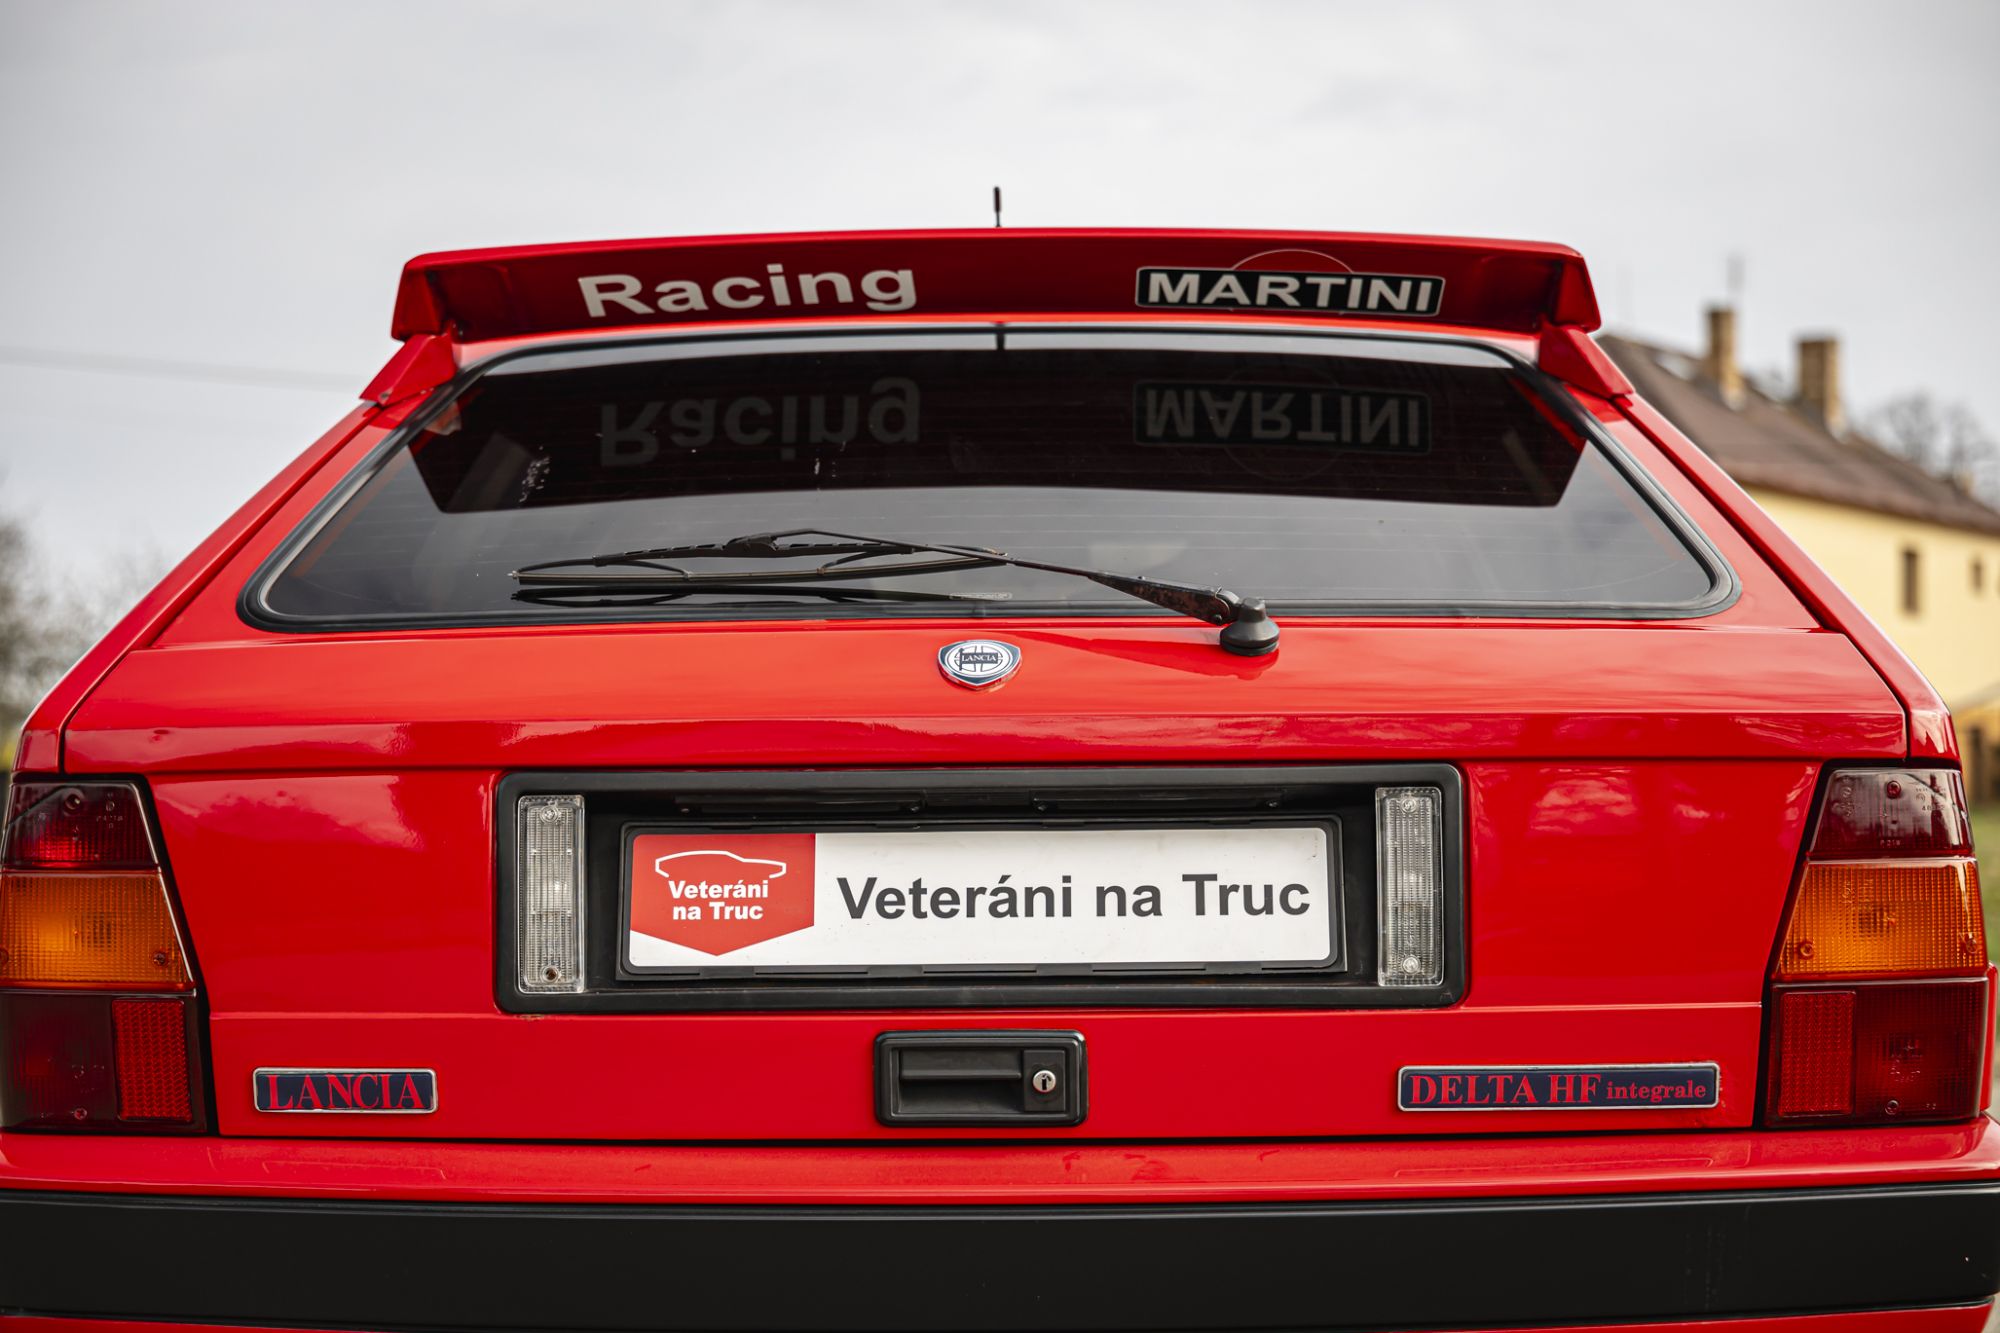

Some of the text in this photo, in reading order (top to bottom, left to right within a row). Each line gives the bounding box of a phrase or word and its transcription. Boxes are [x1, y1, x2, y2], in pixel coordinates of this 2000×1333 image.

[577, 263, 918, 317] Racing
[1148, 272, 1432, 312] MARTINI
[961, 653, 997, 662] LANCIA
[667, 879, 769, 900] Veteráni
[837, 873, 1311, 920] Veteráni na Truc
[672, 900, 764, 921] na Truc
[266, 1073, 426, 1110] LANCIA
[1409, 1073, 1707, 1105] DELTA HF integrale
